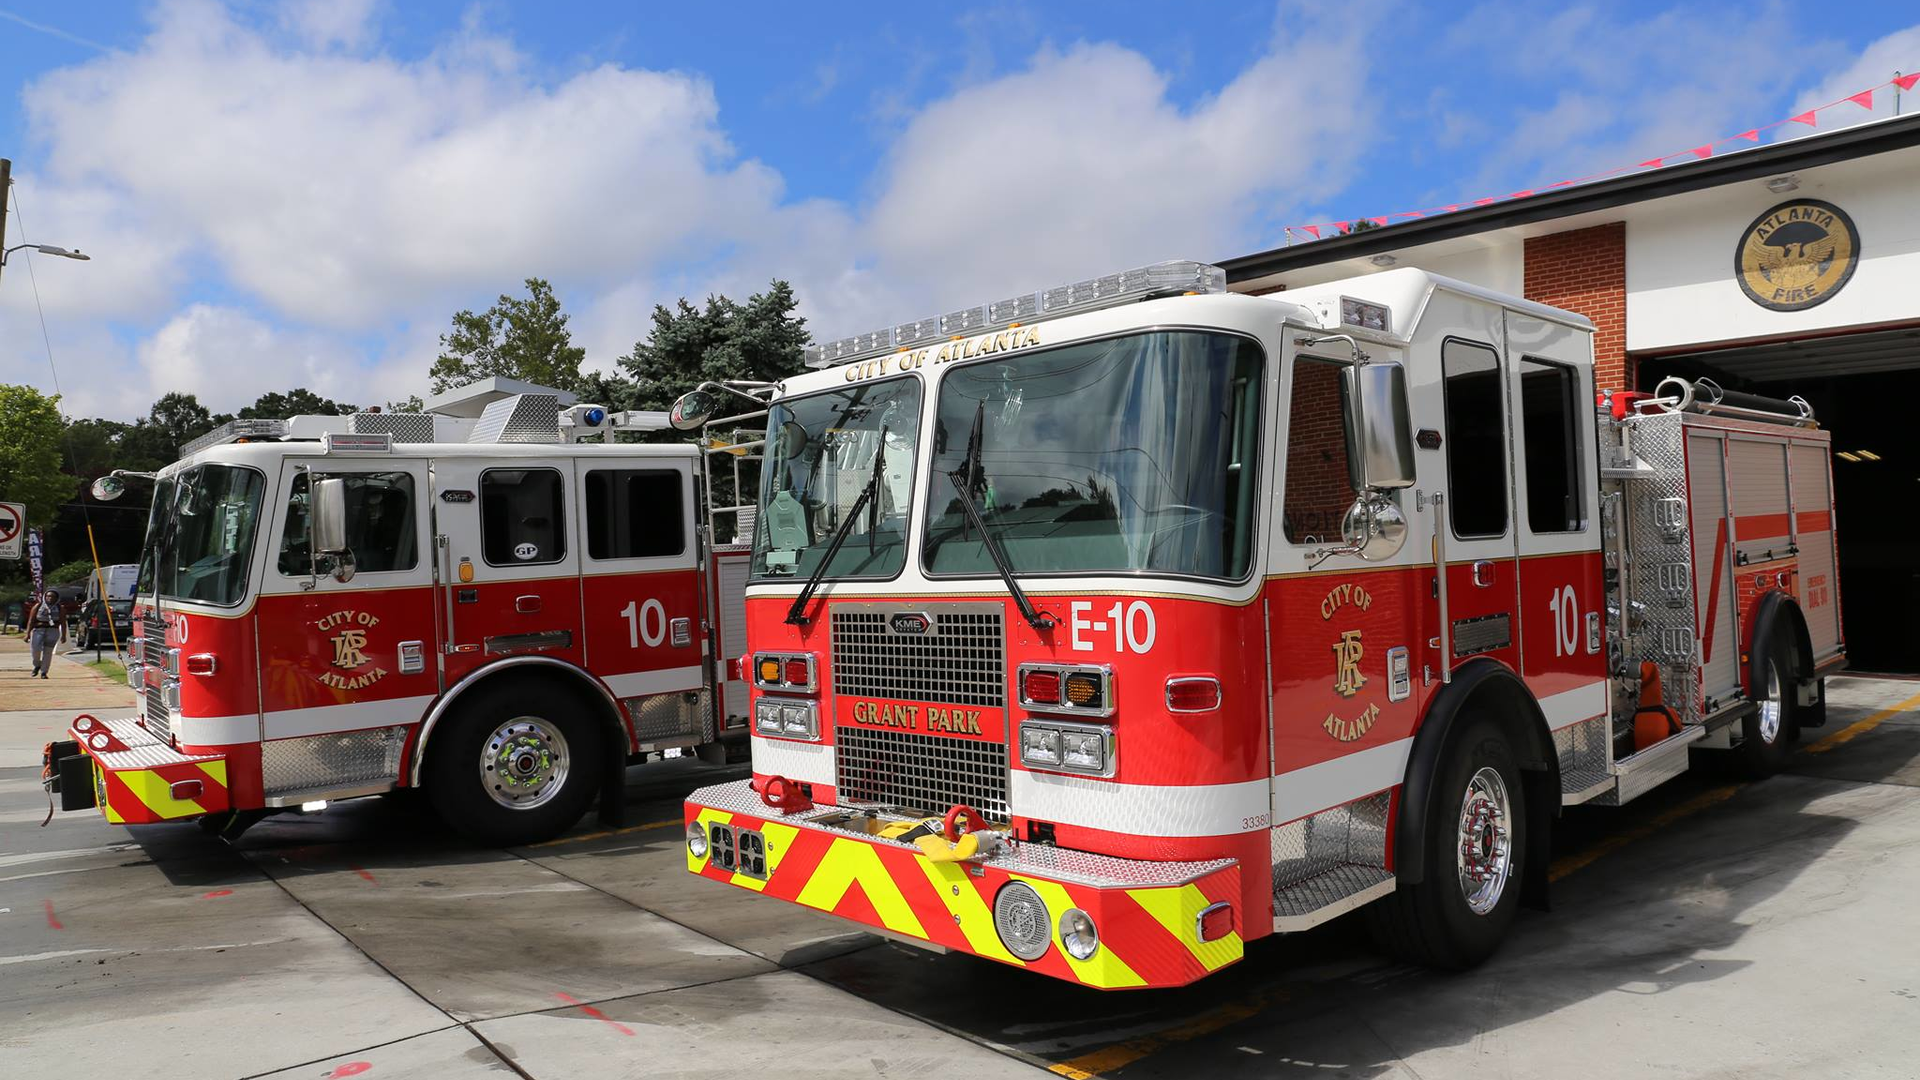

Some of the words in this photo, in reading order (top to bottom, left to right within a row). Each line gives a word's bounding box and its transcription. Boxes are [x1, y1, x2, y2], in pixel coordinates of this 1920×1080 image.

[1756, 208, 1834, 240] ATLANTA
[1772, 284, 1818, 302] FIRE
[845, 357, 891, 382] CITY
[899, 349, 929, 371] OF
[934, 326, 1041, 364] ATLANTA
[515, 546, 537, 556] GP
[1321, 584, 1352, 620] CITY
[1353, 586, 1372, 612] OF
[318, 610, 356, 631] CITY
[357, 612, 380, 628] OF
[620, 598, 667, 648] 10
[895, 620, 921, 628] KME
[1071, 600, 1156, 654] E-10
[1549, 585, 1578, 658] 10
[318, 667, 388, 690] ATLANTA
[853, 701, 919, 728] GRANT
[926, 707, 982, 734] PARK
[1322, 702, 1380, 742] ATLANTA
[1242, 813, 1269, 829] 33380
